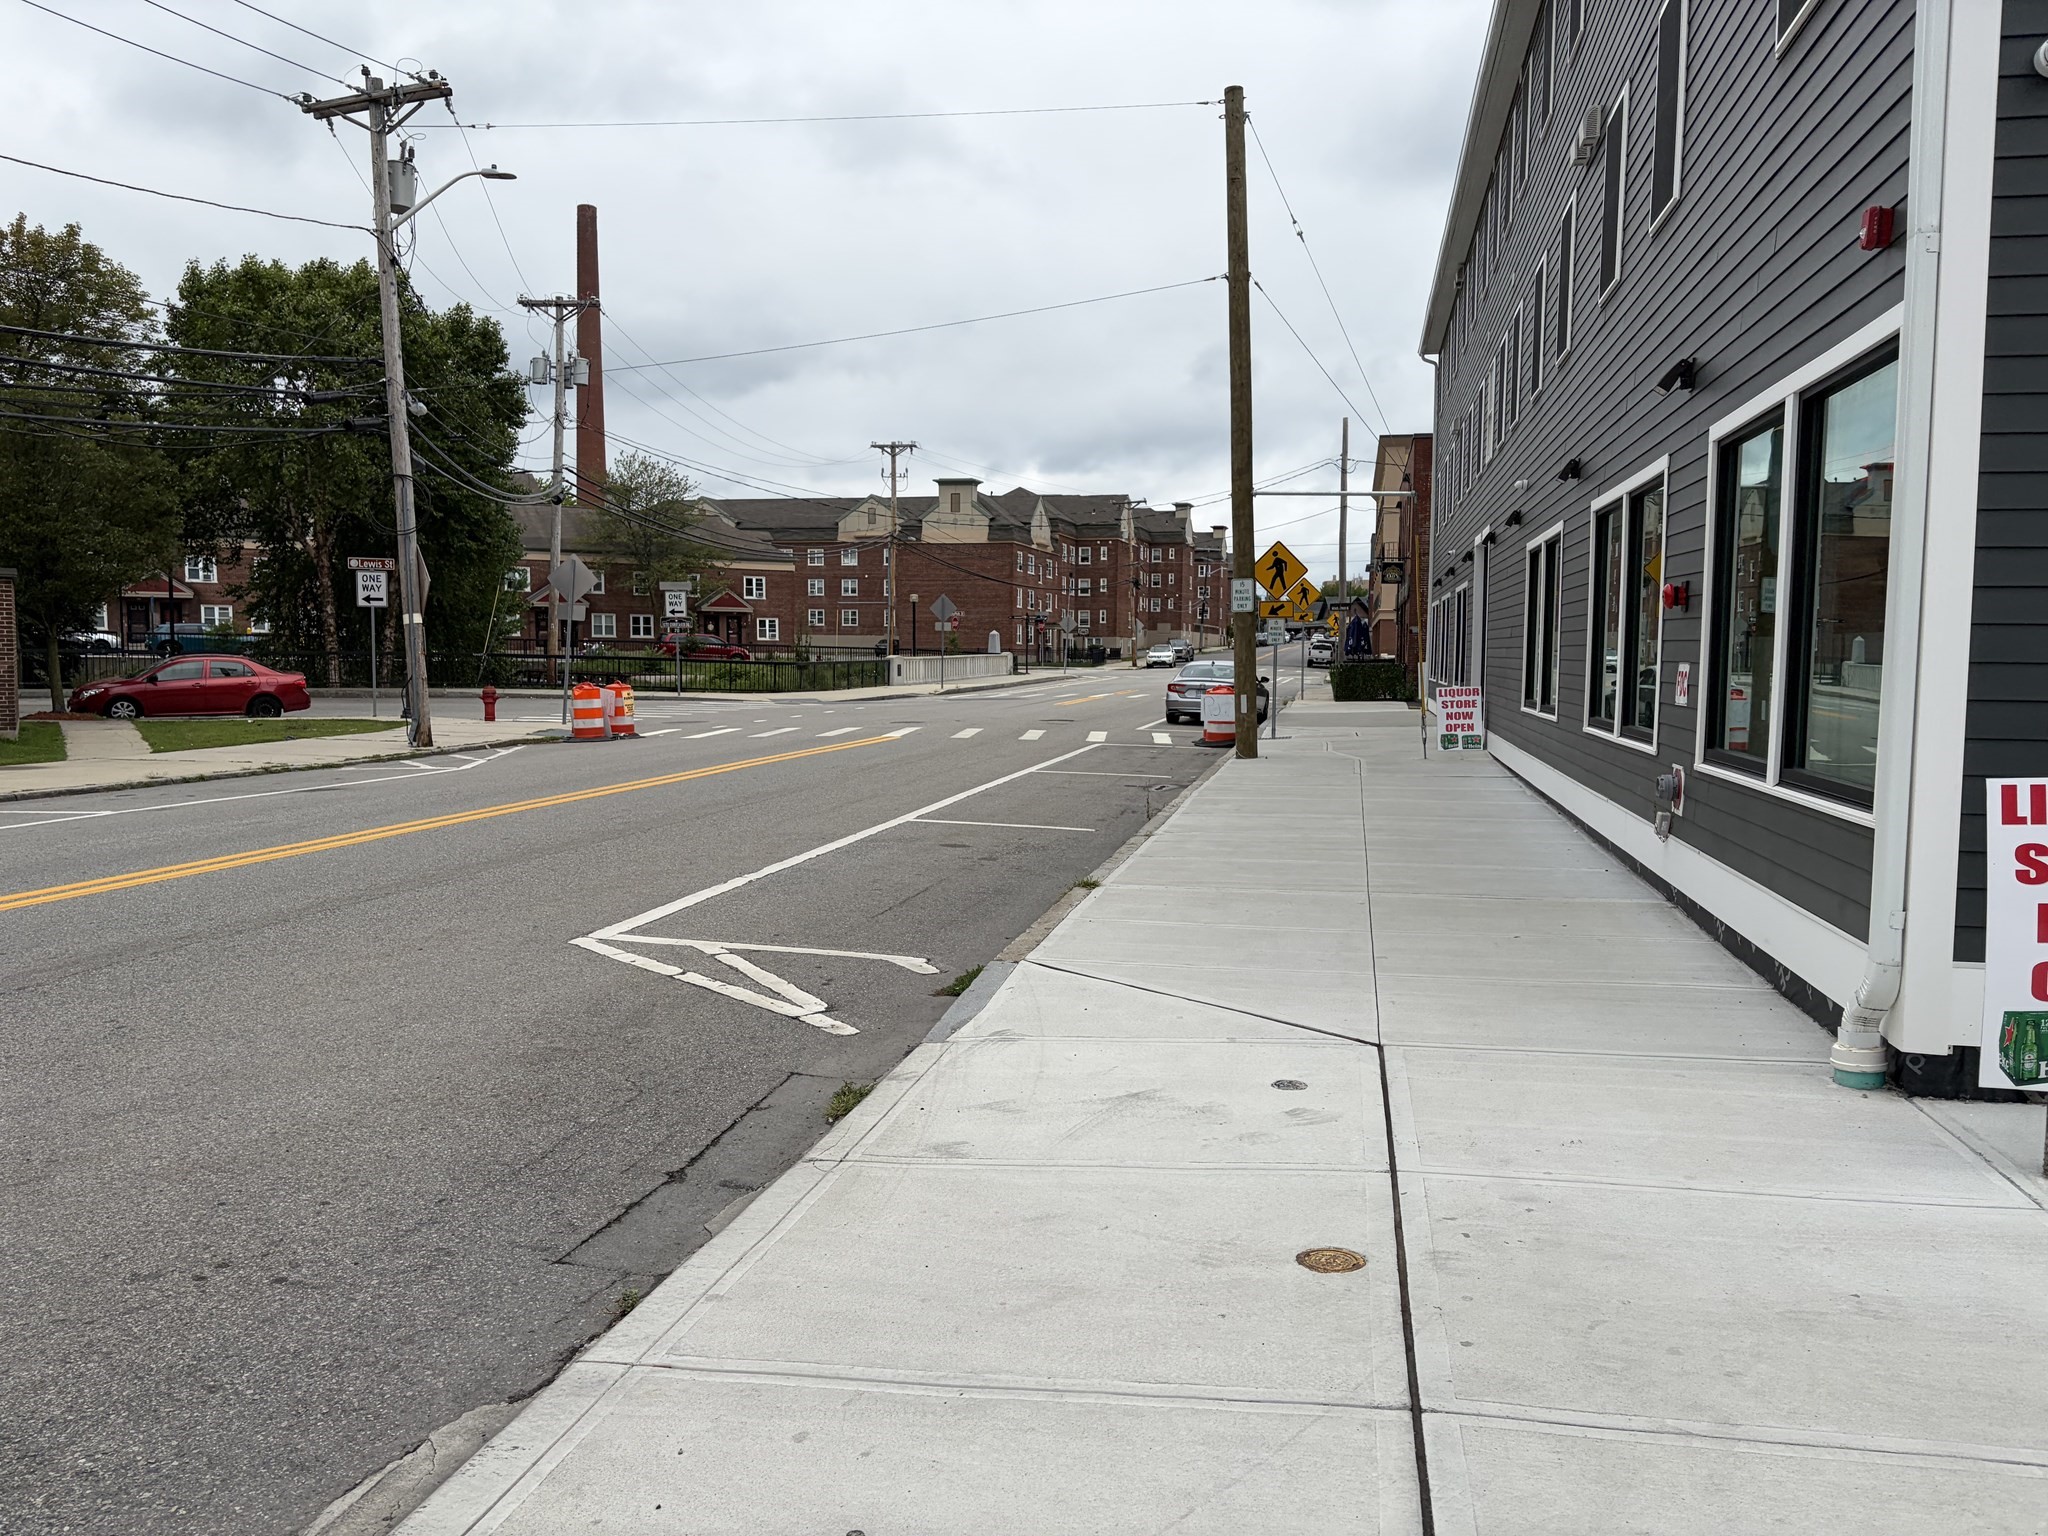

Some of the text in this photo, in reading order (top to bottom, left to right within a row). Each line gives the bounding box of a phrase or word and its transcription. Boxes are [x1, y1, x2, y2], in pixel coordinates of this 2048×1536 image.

[359, 559, 393, 569] Lewis St
[361, 574, 382, 583] ONE
[361, 584, 382, 592] WAY
[1438, 687, 1480, 698] LIQUOR
[1441, 699, 1478, 709] STORE
[1445, 711, 1474, 721] NOW
[1445, 723, 1475, 733] OPEN
